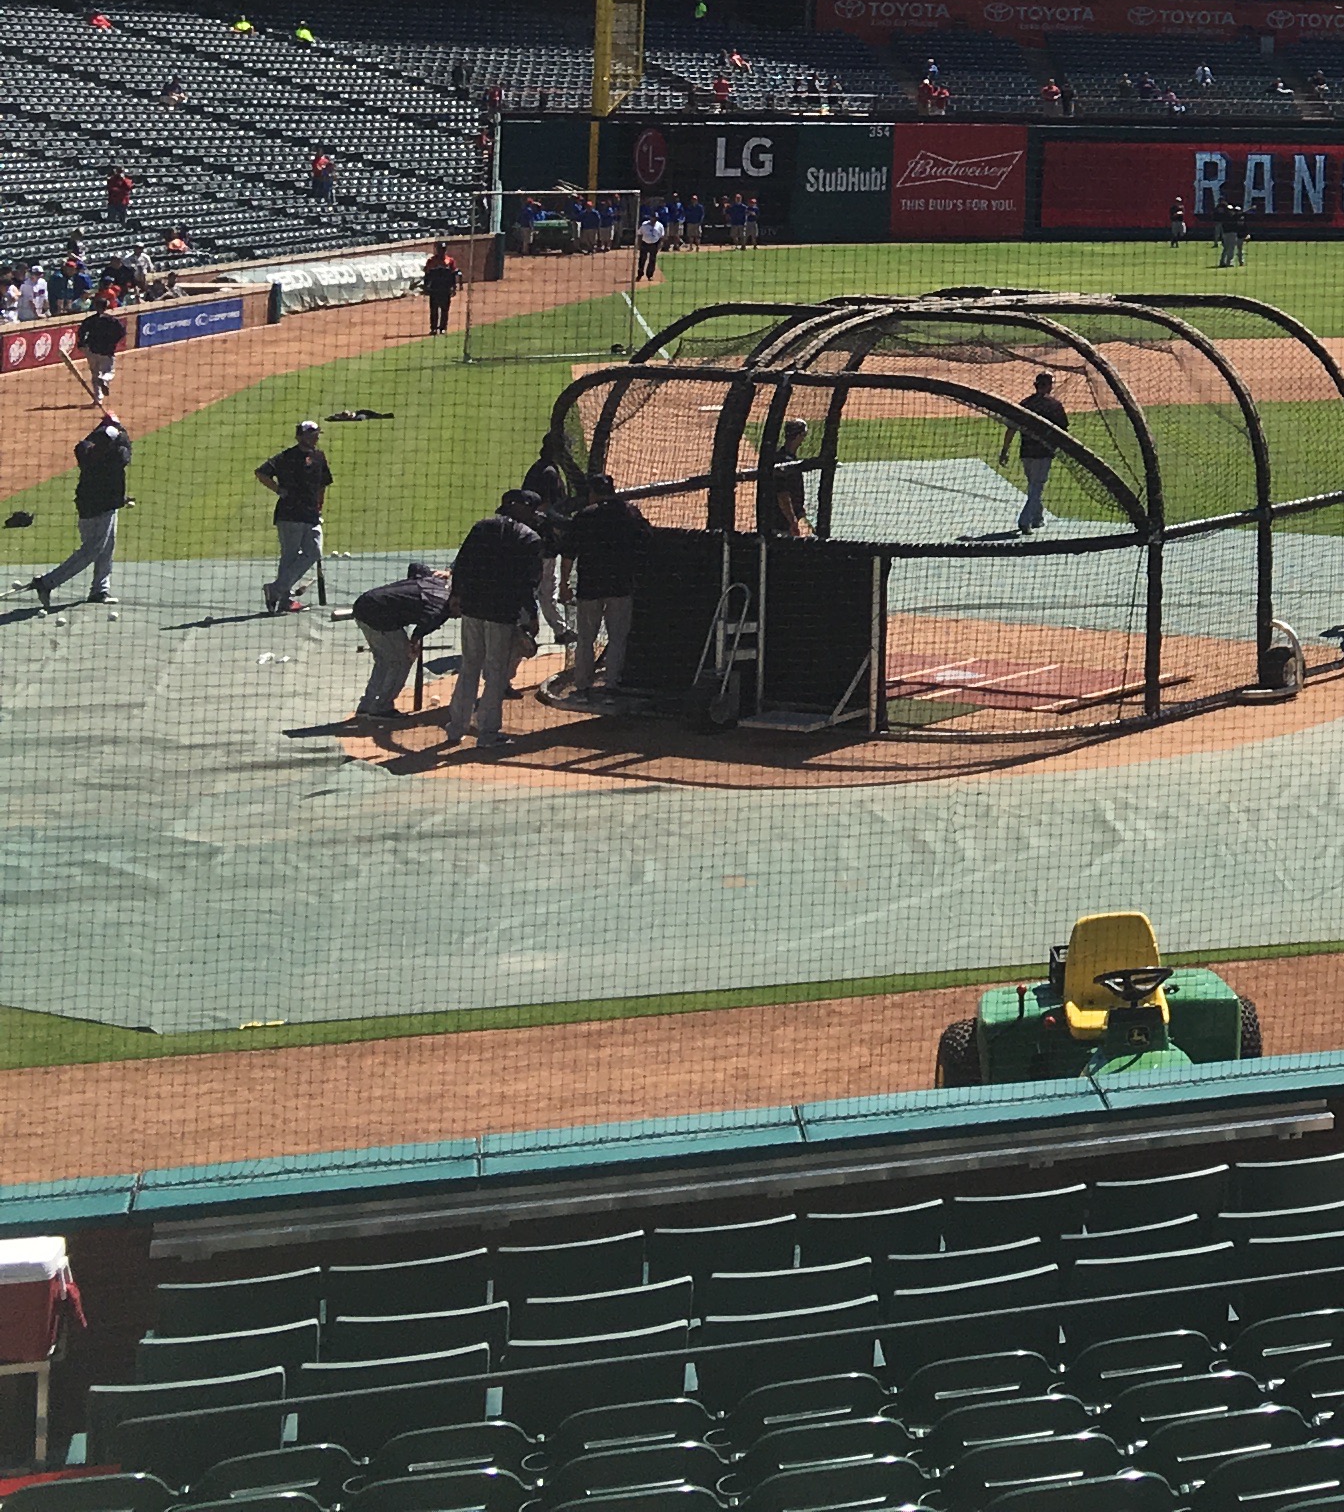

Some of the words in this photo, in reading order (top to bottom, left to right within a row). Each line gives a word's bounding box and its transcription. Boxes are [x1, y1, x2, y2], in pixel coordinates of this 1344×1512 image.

[870, 2, 950, 20] TOYOTA
[1013, 5, 1095, 23] TOYOTA
[1159, 9, 1237, 27] TOYOTA
[870, 127, 889, 137] 354
[714, 137, 775, 178] LG
[908, 159, 1011, 178] Budweiser
[806, 167, 888, 192] StubHub!
[901, 199, 924, 210] THIS
[929, 199, 962, 211] BUD'S
[967, 199, 987, 211] FOR
[991, 200, 1016, 211] YOU.
[266, 270, 313, 292] GEICO
[312, 264, 357, 286] GEICO
[357, 261, 397, 283] GEICO
